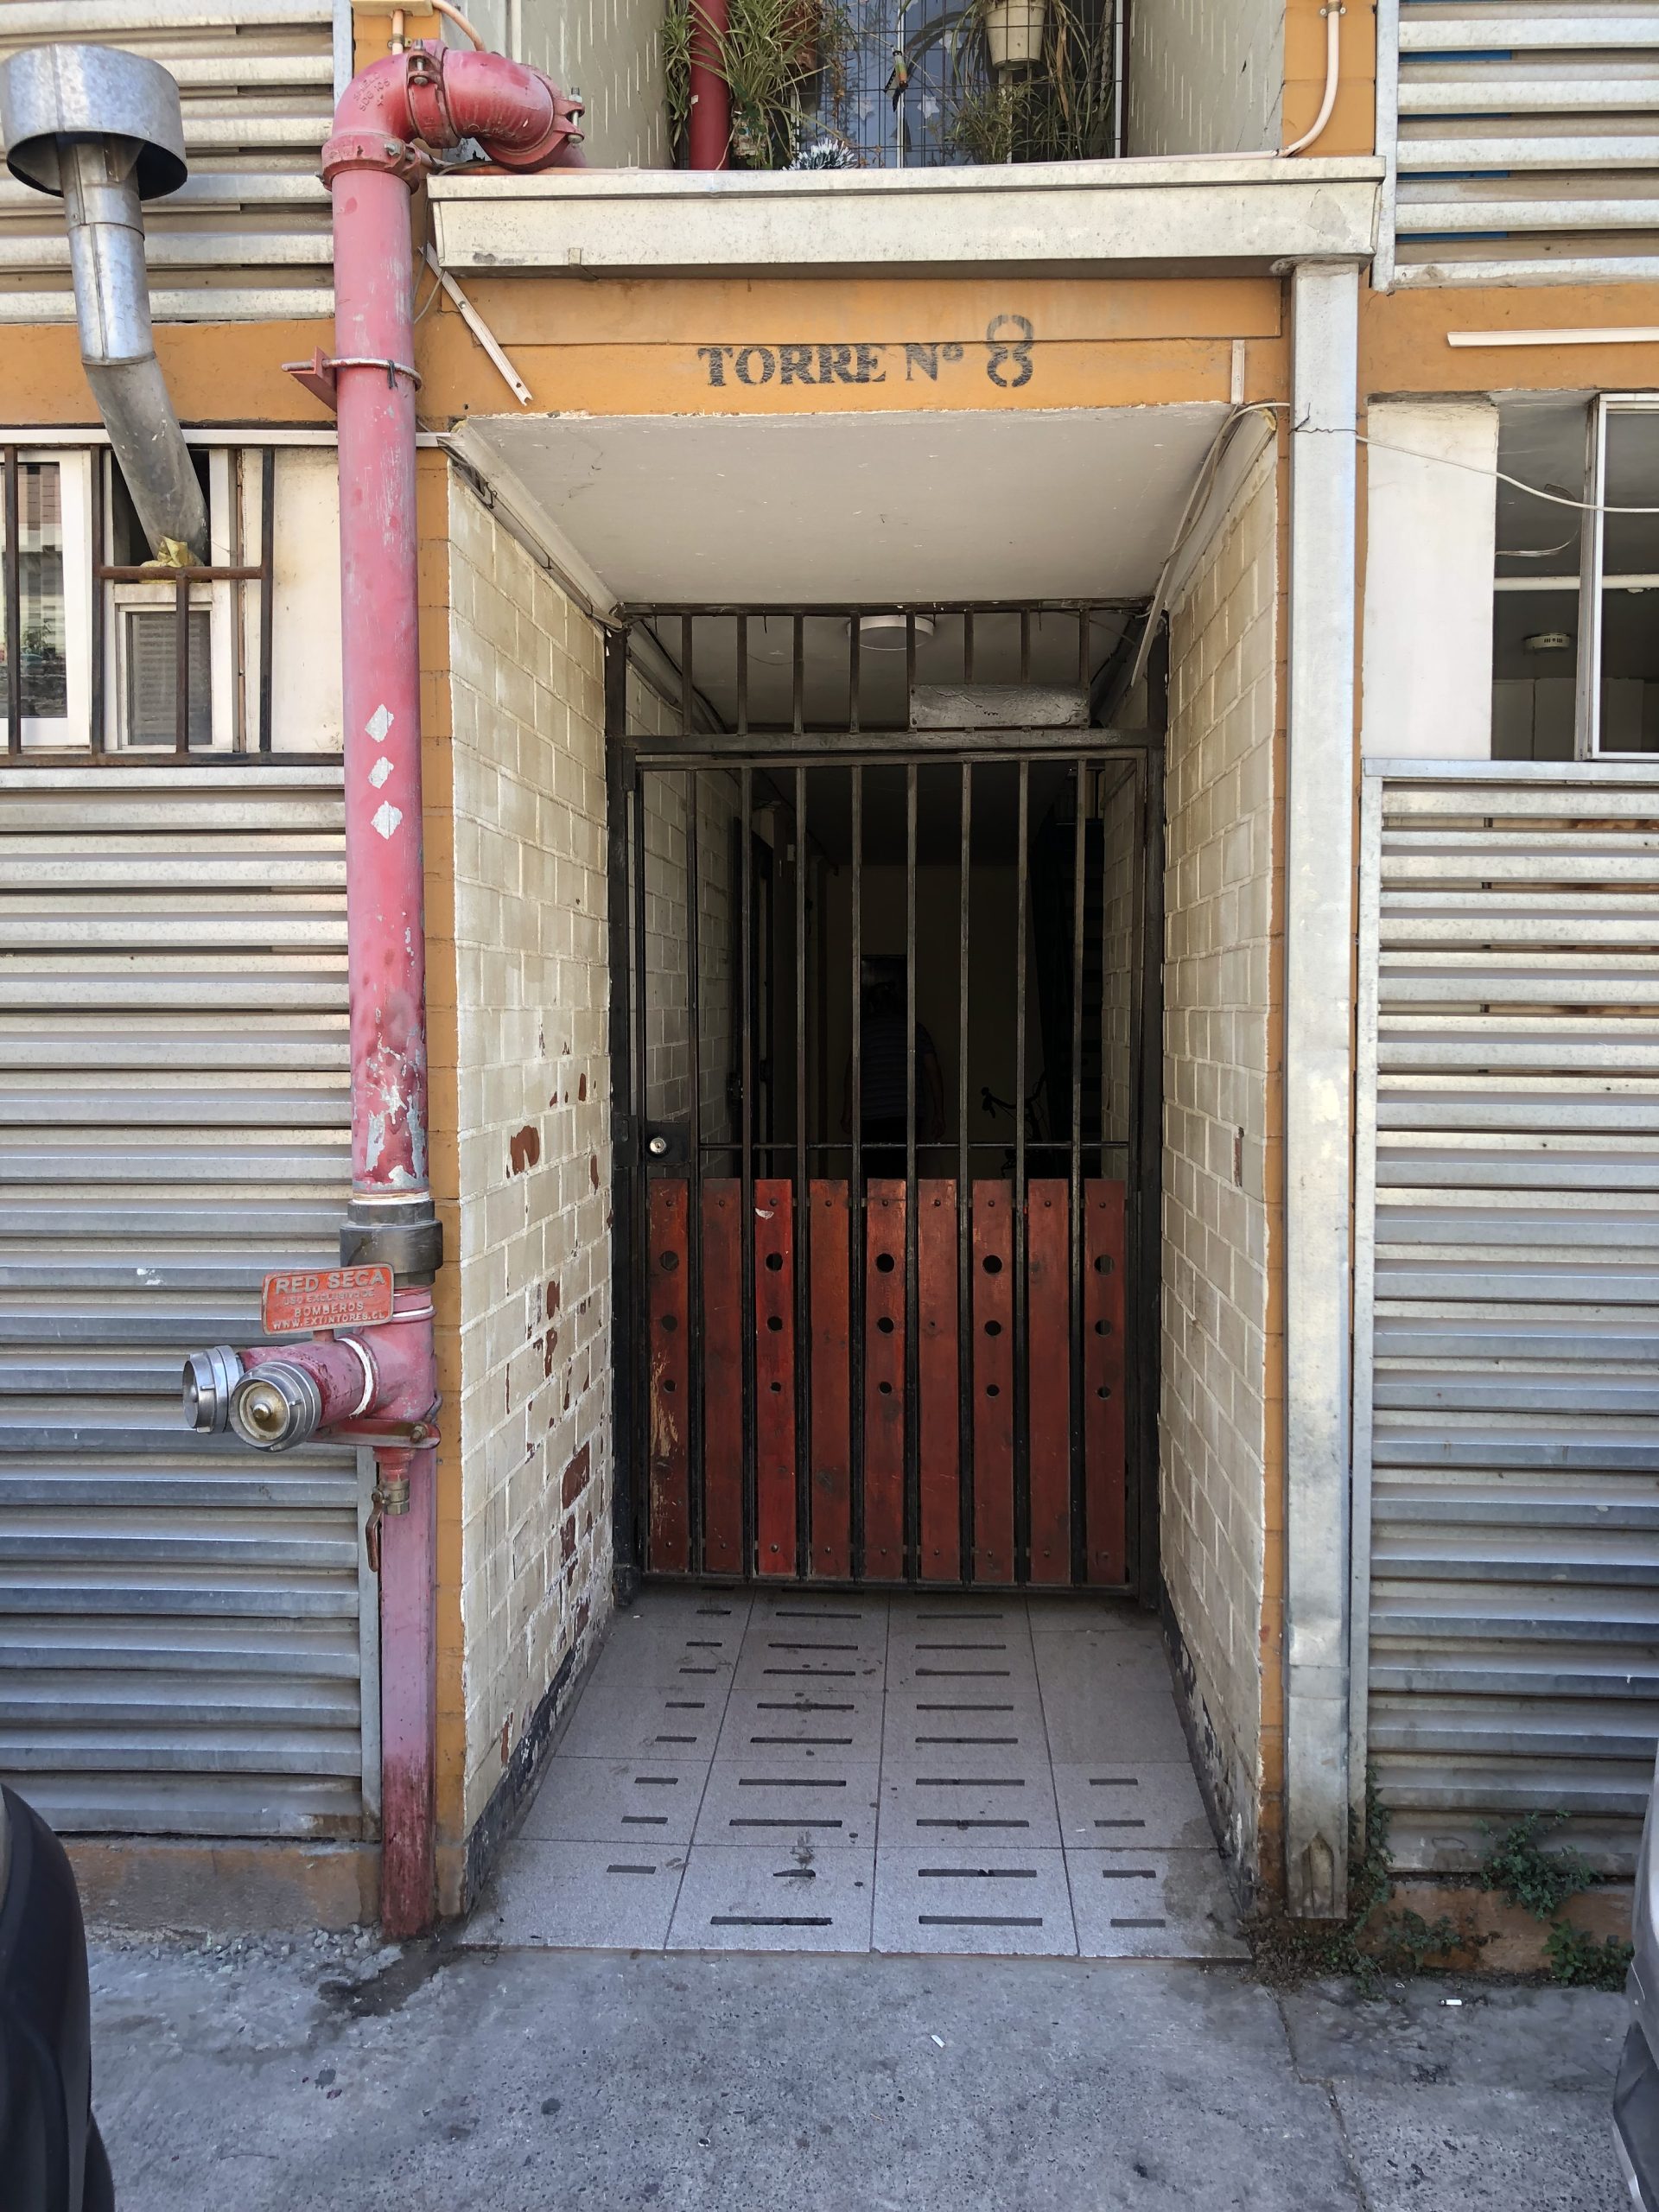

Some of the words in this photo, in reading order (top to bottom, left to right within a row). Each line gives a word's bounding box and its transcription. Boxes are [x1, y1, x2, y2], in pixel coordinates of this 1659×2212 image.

[698, 345, 887, 387] TORRE
[986, 314, 1034, 388] 8
[276, 1276, 320, 1294] RED
[327, 1268, 385, 1289] SECA
[283, 1296, 303, 1306] USO
[306, 1289, 359, 1304] EXCLUSIVO
[361, 1288, 375, 1298] DE
[294, 1301, 365, 1318] BOMBEROS
[272, 1311, 385, 1331] WWW.EXTINTORES.CL
